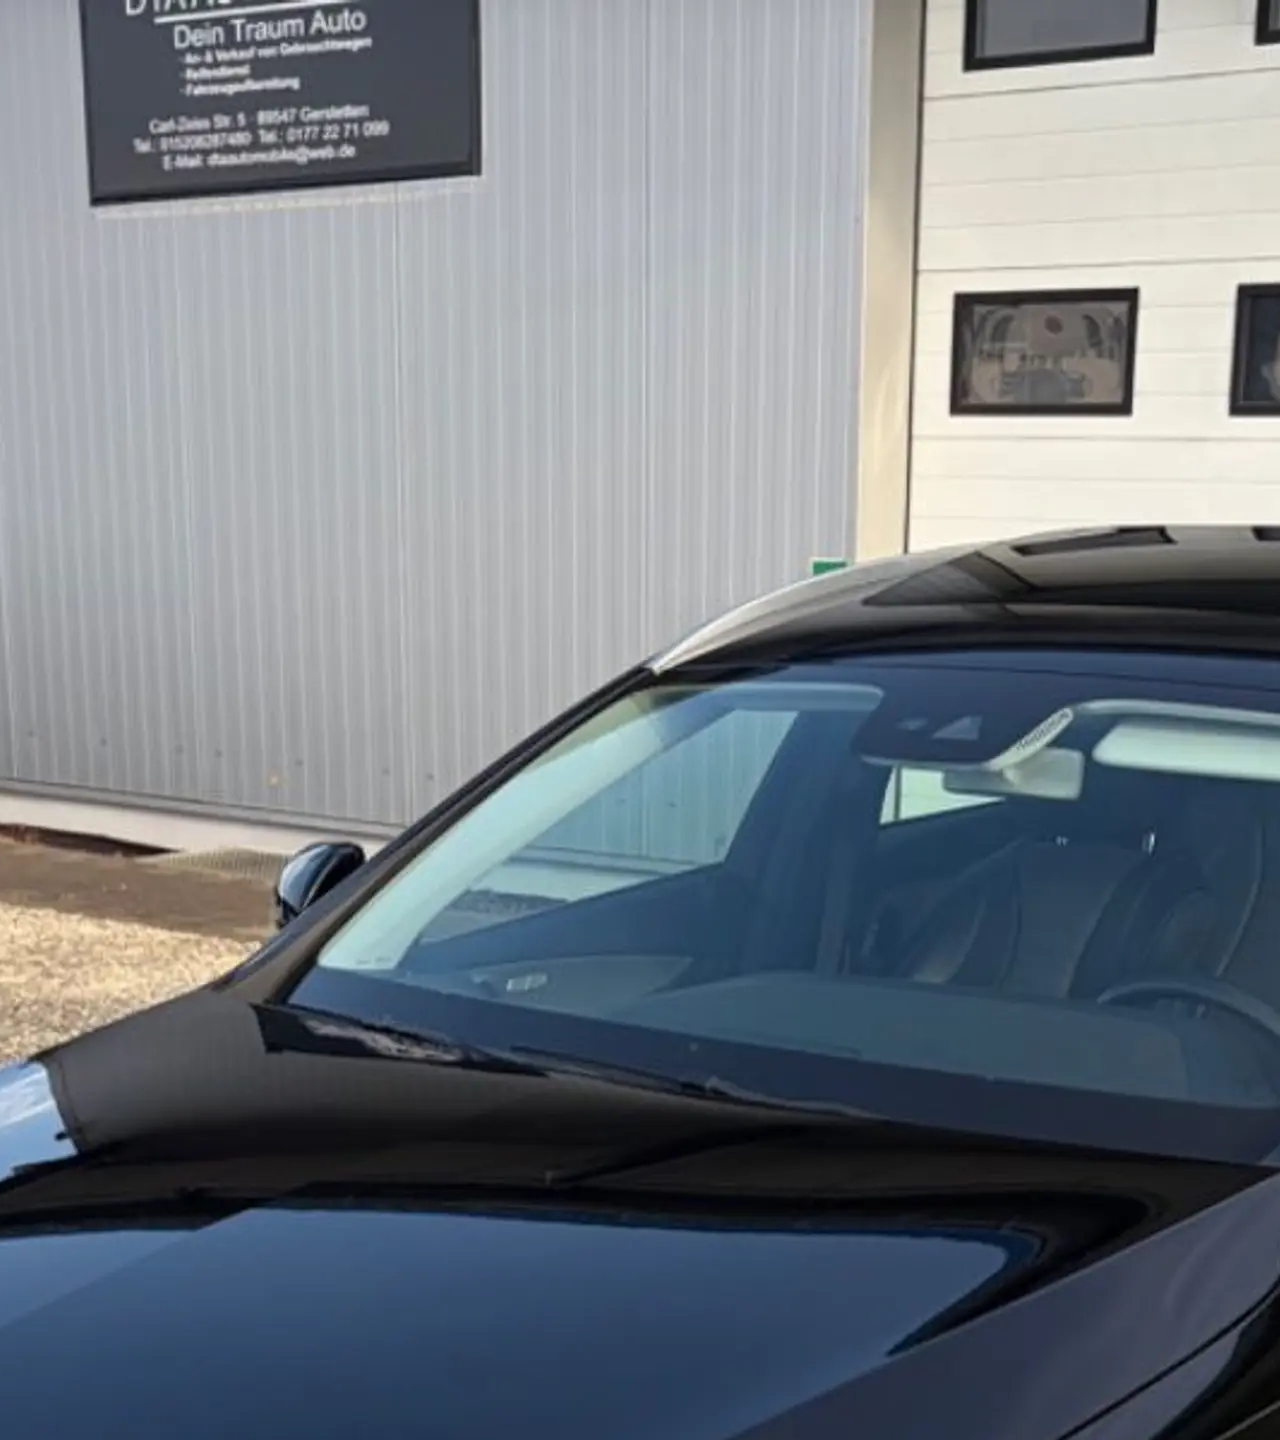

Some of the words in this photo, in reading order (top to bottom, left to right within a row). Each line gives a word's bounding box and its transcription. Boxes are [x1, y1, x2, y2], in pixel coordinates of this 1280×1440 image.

[174, 22, 224, 49] Dein
[230, 18, 305, 43] Traum
[310, 9, 367, 34] Auto
[286, 125, 320, 143] 0177
[322, 122, 340, 141] 22
[343, 121, 359, 139] 71
